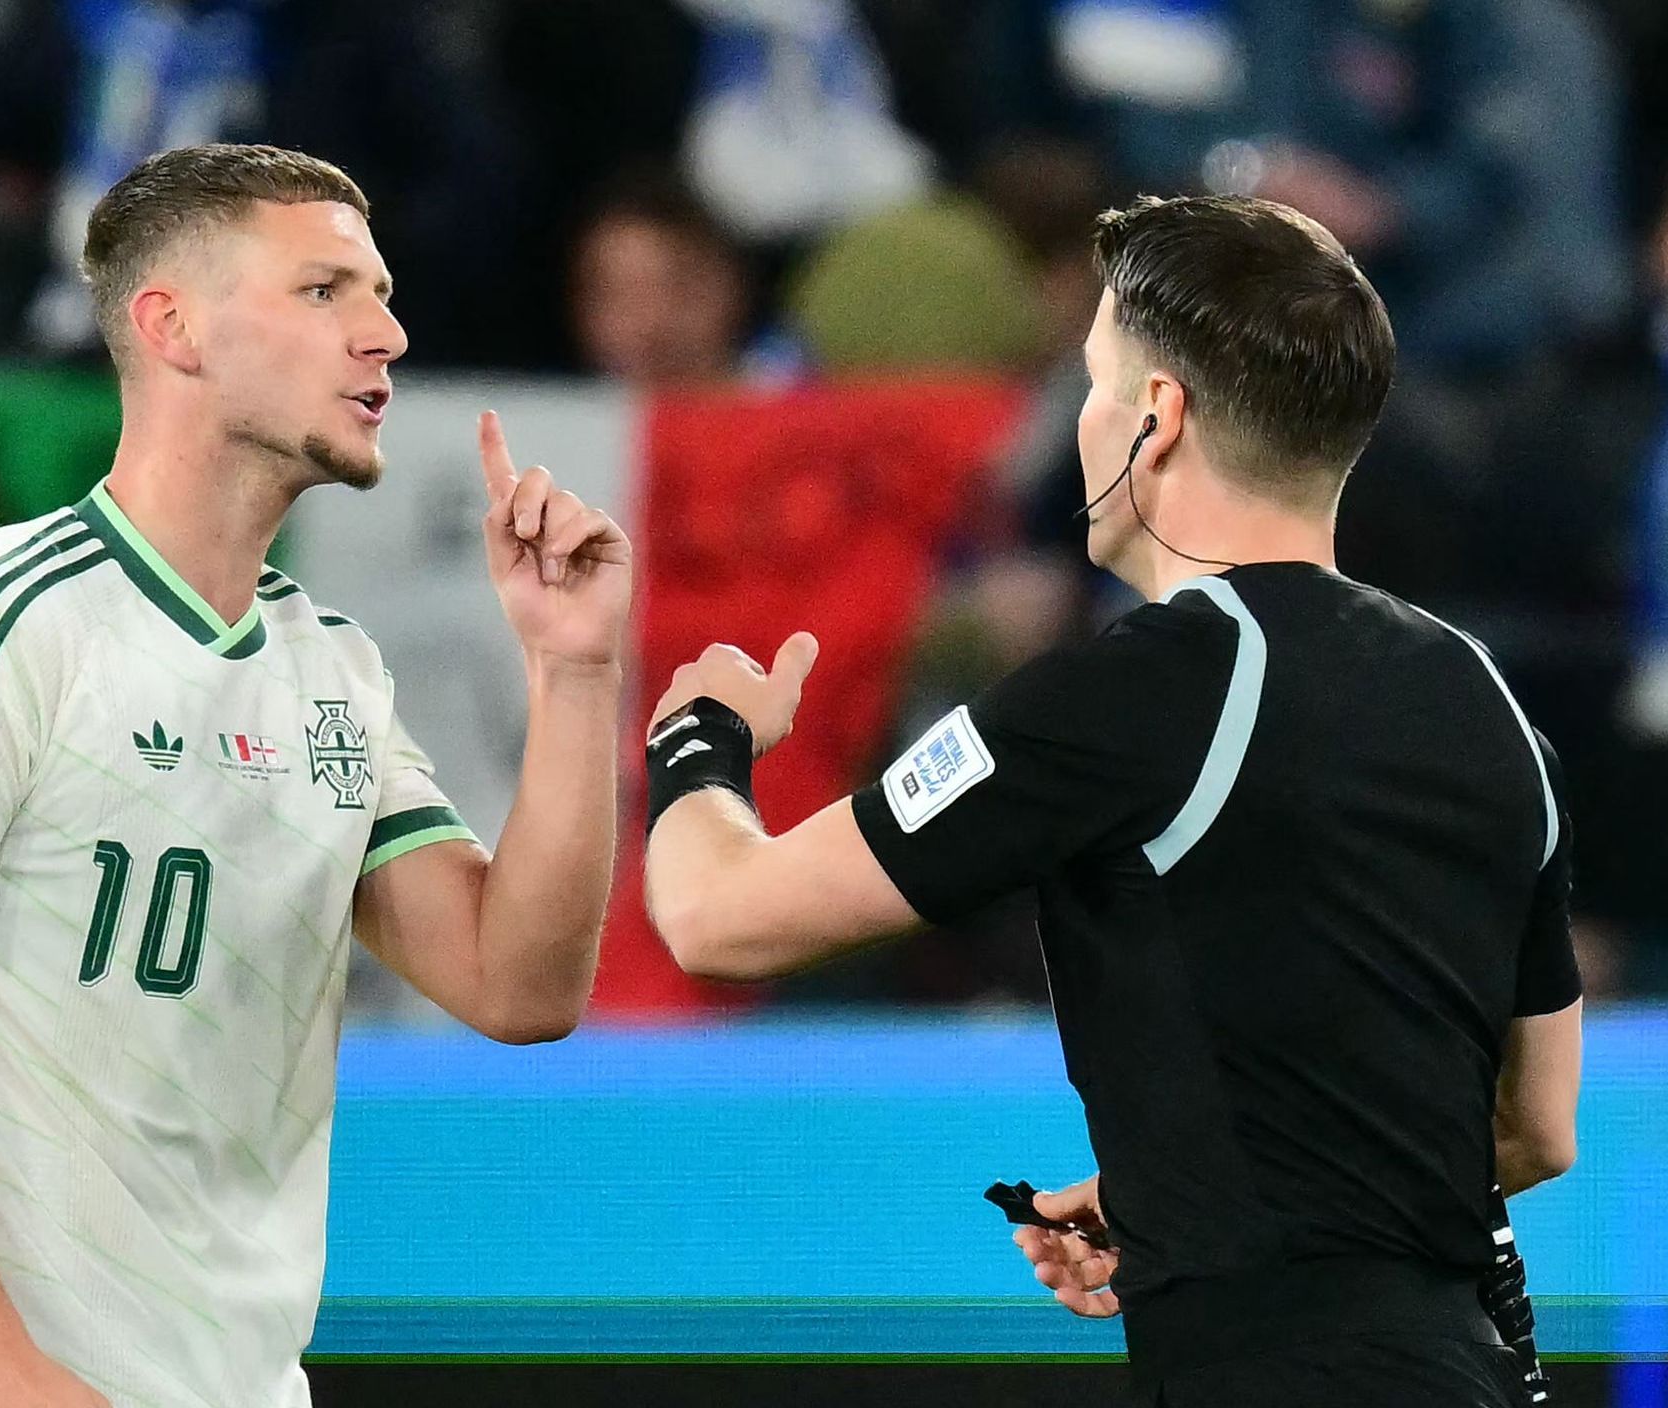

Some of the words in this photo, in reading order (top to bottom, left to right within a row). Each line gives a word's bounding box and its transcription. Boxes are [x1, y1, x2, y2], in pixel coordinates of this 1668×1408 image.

[927, 737, 957, 782] UNITES
[942, 727, 968, 770] FOOTBALL
[918, 763, 942, 797] World
[77, 839, 214, 1000] 10
